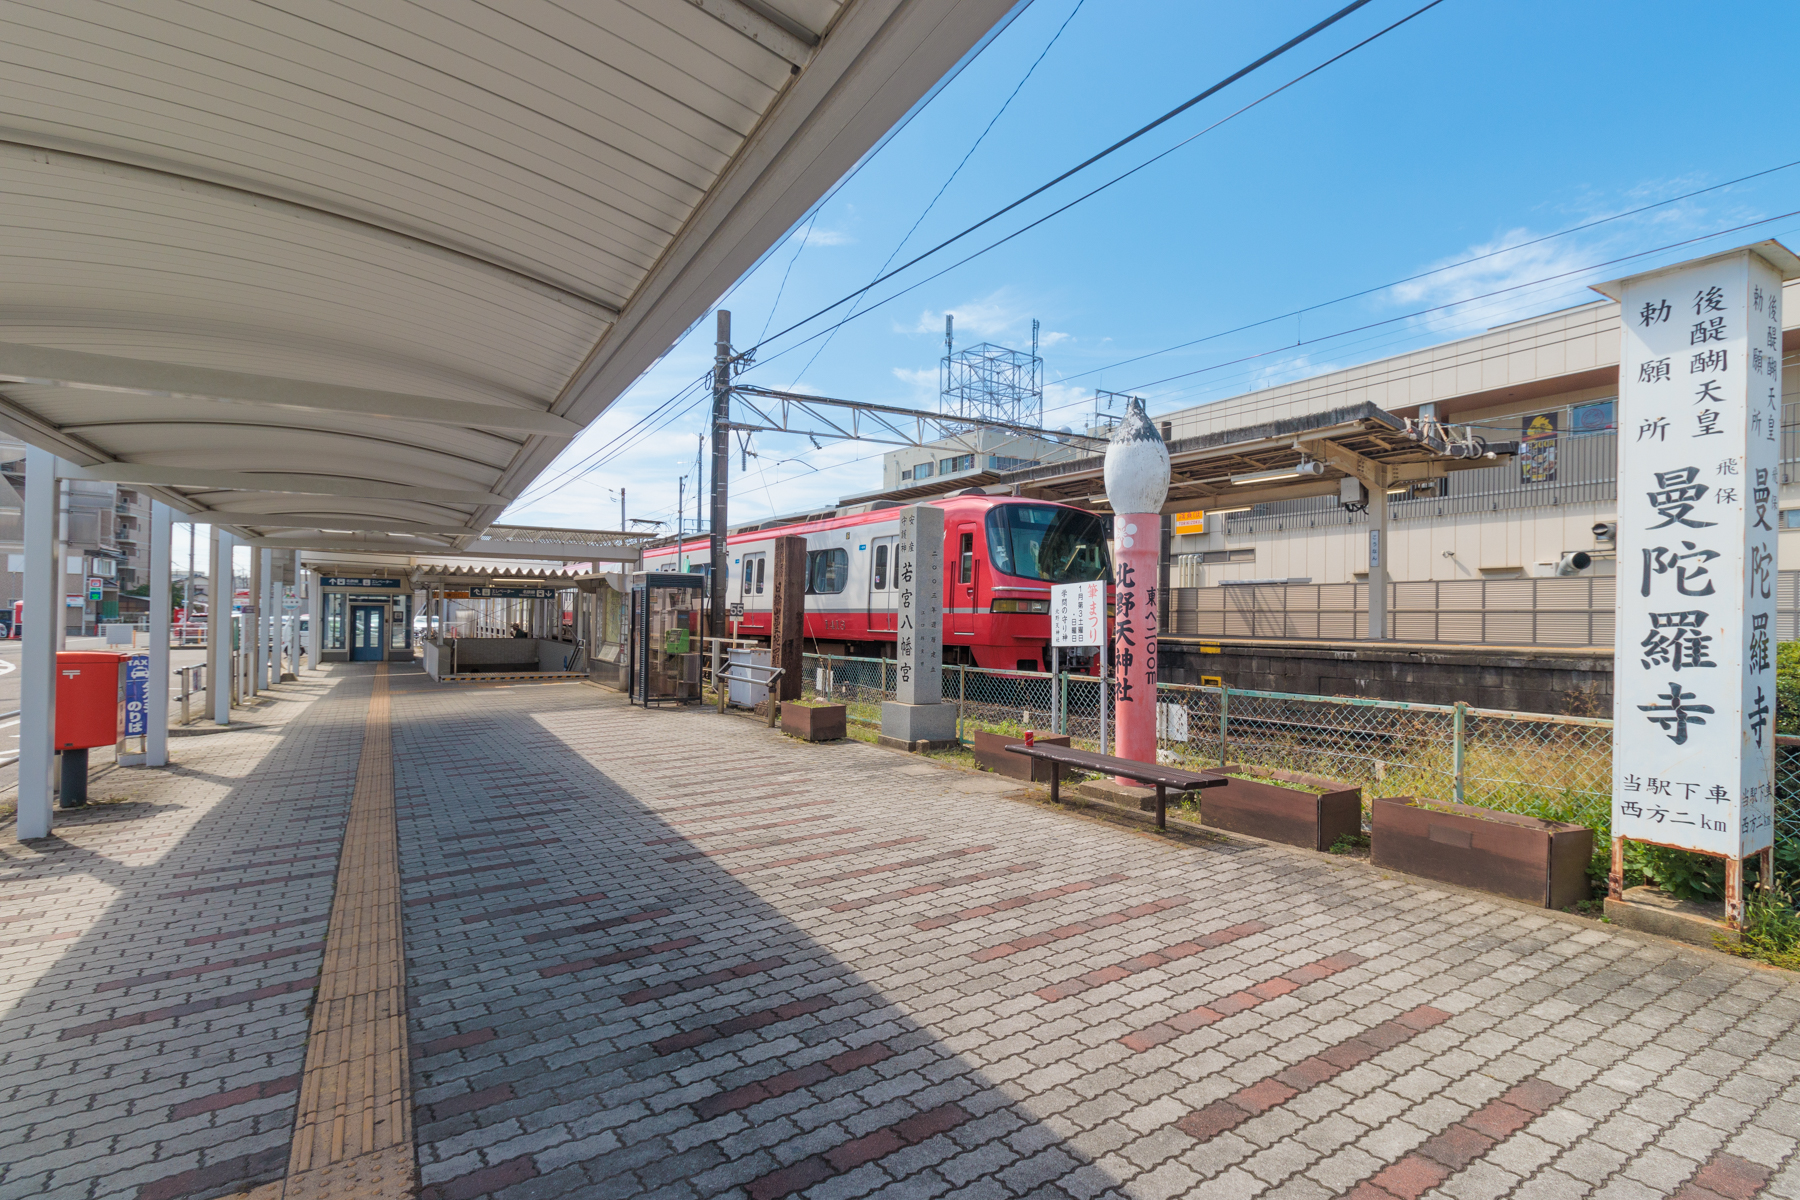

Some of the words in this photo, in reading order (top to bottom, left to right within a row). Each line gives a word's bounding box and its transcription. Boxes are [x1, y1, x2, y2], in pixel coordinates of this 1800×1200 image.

[1636, 299, 1672, 442] 勅願所
[1690, 286, 1729, 438] 後醍醐天皇
[1715, 458, 1739, 504] 飛保
[730, 604, 744, 616] 55
[825, 620, 846, 630] 1413
[900, 561, 913, 683] 若宮八幡宮
[1088, 583, 1099, 644] 筆まつり
[1116, 562, 1136, 703] 北野天神社
[1637, 466, 1721, 745] 曼陀羅寺
[1748, 468, 1773, 749] 曼陀羅寺
[127, 701, 143, 733] のりば
[1621, 801, 1727, 833] 西方二km
[1623, 773, 1730, 804] 当駅下車
